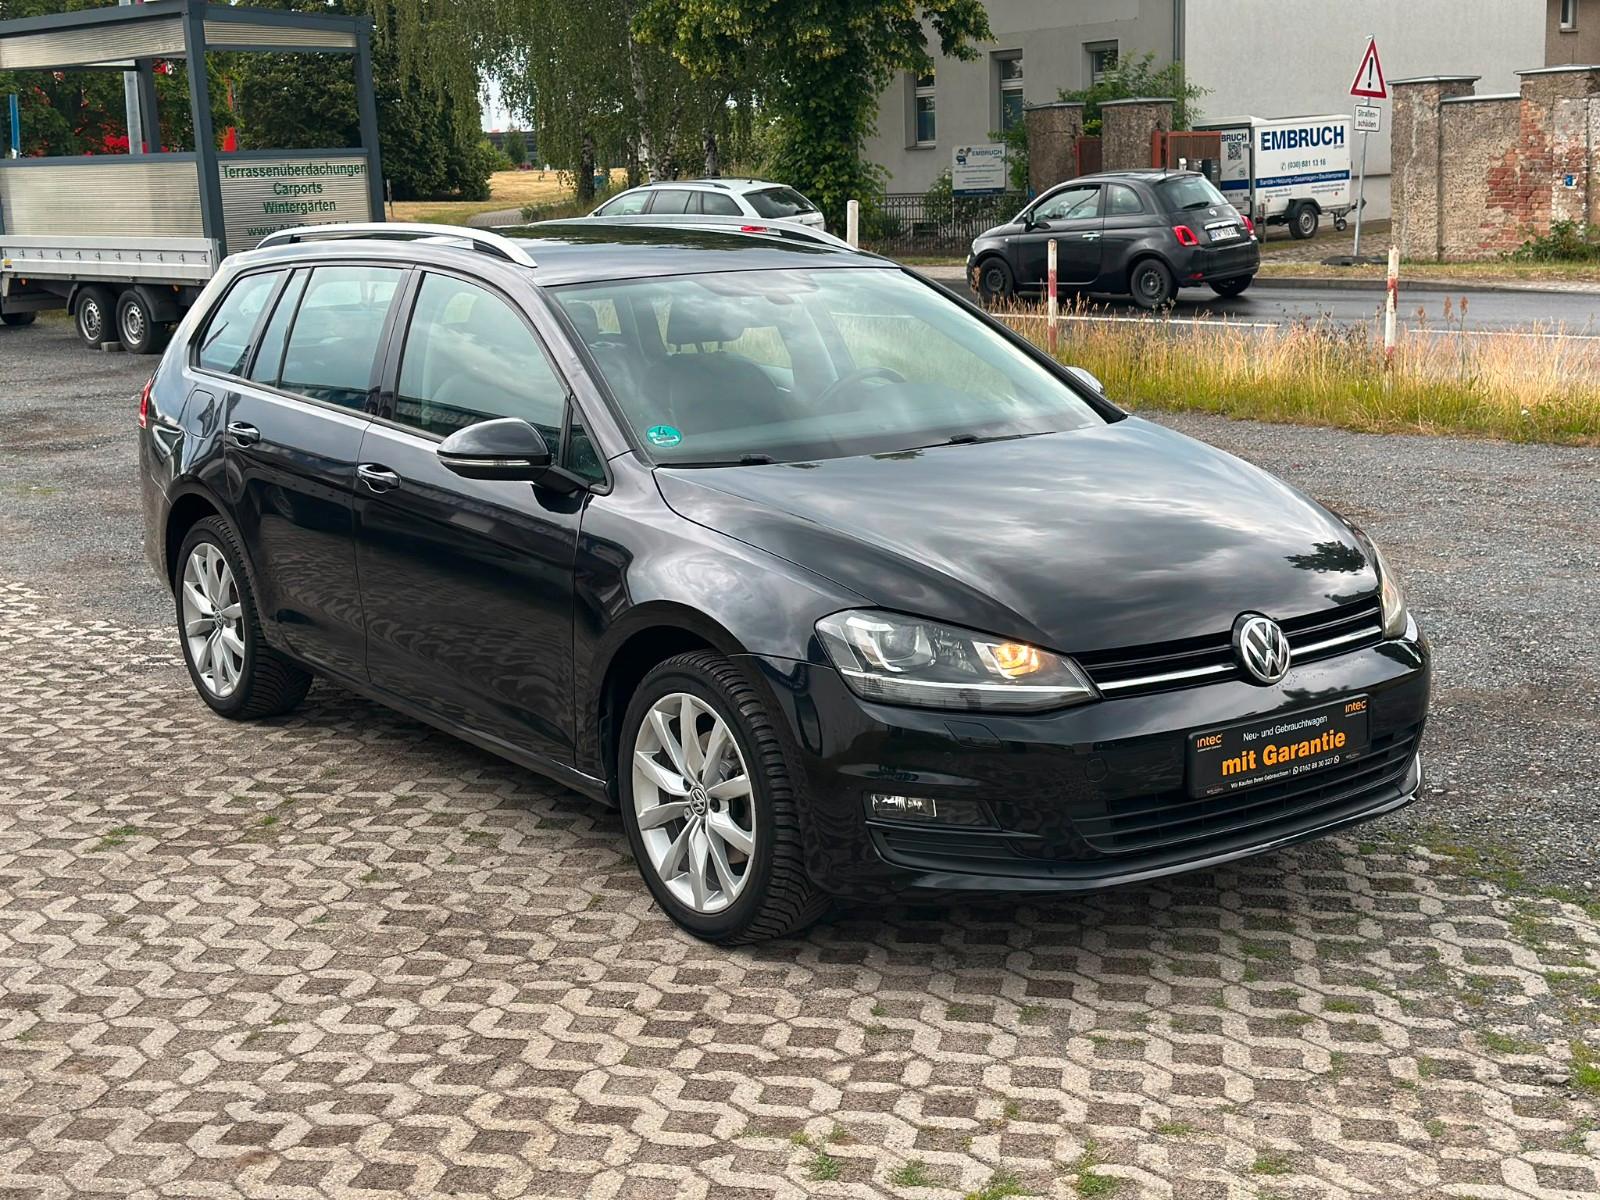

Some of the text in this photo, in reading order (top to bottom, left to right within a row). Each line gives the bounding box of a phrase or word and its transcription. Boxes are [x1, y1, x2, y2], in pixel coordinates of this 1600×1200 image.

[1260, 125, 1345, 152] EMBRUCH
[222, 163, 366, 178] Terrassenüberdachungen
[273, 181, 323, 196] Carports
[262, 199, 337, 215] Wintergärten
[1345, 700, 1367, 713] intec
[1243, 715, 1328, 742] Neu- und Gebrauchtwagen
[1196, 734, 1222, 748] intec
[1221, 729, 1346, 776] mit Garantie
[1238, 778, 1254, 788] Kaufen
[1299, 764, 1311, 772] 0162
[1324, 757, 1334, 766] 327
